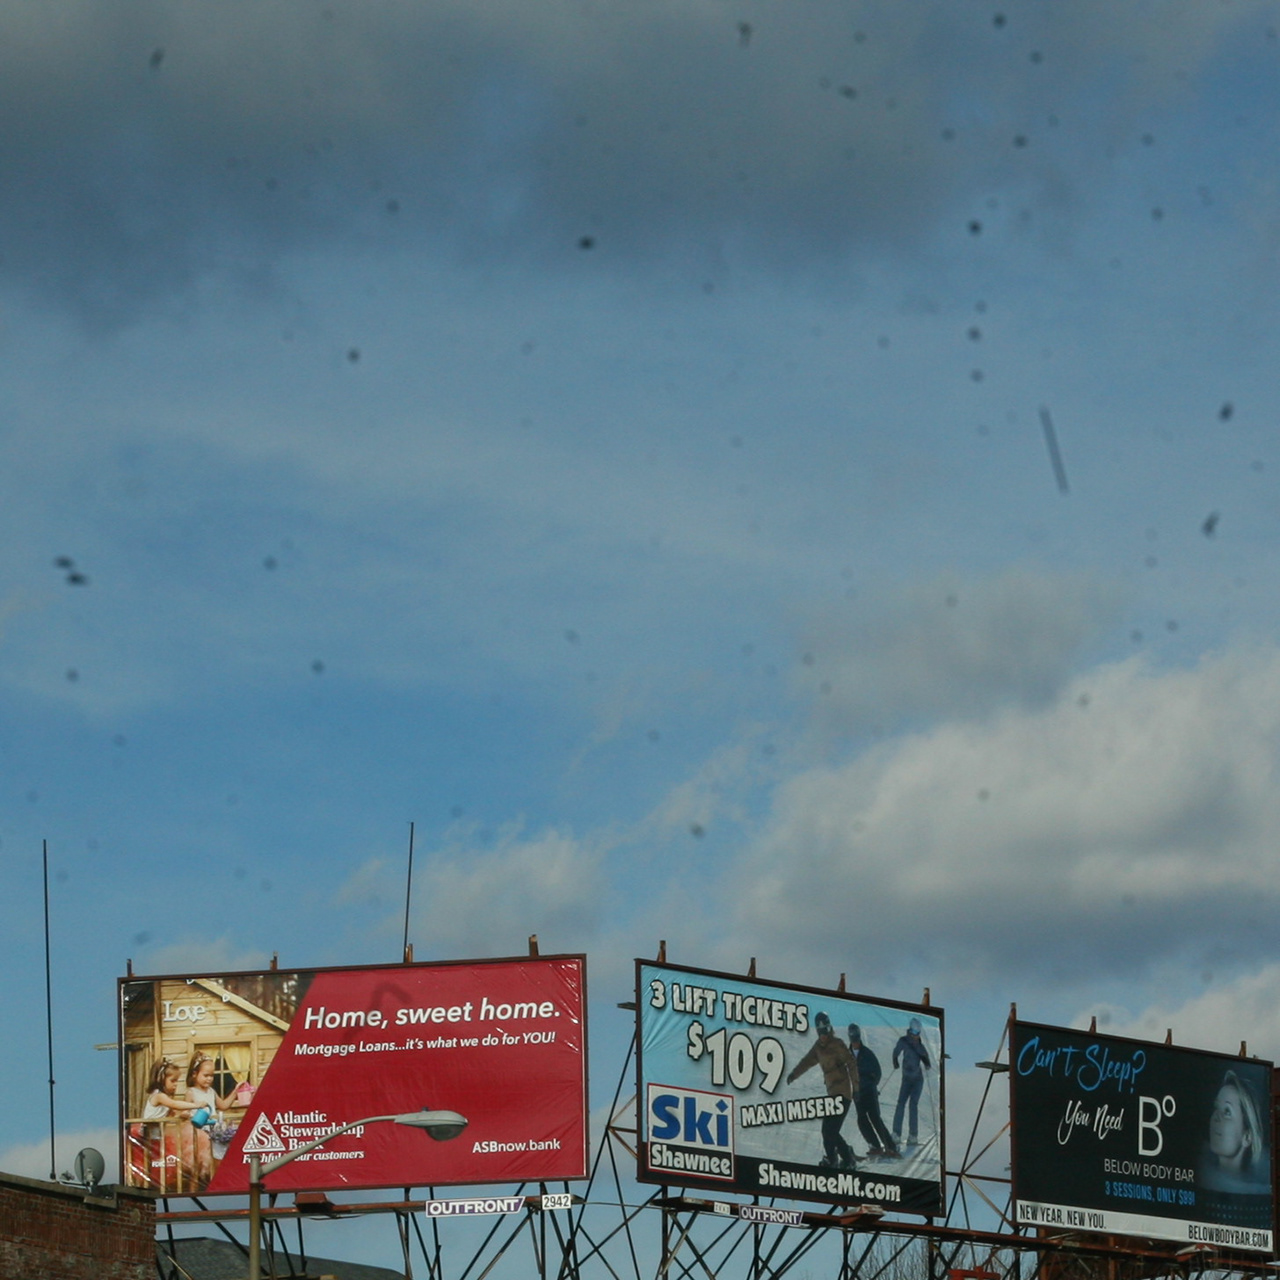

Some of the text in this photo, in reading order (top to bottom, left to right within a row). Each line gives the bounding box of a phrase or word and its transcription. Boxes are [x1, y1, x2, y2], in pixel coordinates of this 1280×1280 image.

[163, 1001, 206, 1023] Love
[304, 997, 560, 1030] Home, sweet home.
[650, 979, 809, 1032] 3 LIFT TICKETS
[294, 1042, 355, 1057] Mortgage
[426, 1036, 458, 1049] what
[460, 1038, 478, 1048] we
[482, 1034, 499, 1046] do
[501, 1033, 520, 1047] for
[522, 1031, 555, 1044] YOU!
[687, 1020, 785, 1094] $109
[1077, 1044, 1146, 1094] Sleep?
[273, 1110, 327, 1125] Atlantic
[651, 1094, 729, 1147] Ski
[741, 1095, 845, 1128] MAXI MISERS
[1058, 1099, 1125, 1145] You Need
[314, 1150, 365, 1161] customers
[472, 1138, 561, 1153] ASBnow.bank
[651, 1143, 731, 1175] Shawnee
[1104, 1158, 1195, 1183] BELOW BODY BAR
[758, 1163, 901, 1202] ShawneeMt.com
[1105, 1181, 1111, 1196] 3
[1156, 1187, 1176, 1203] ONLY
[429, 1198, 520, 1214] OUTFRONT
[543, 1196, 570, 1208] 2942
[740, 1206, 799, 1224] OUTFRONT
[1020, 1204, 1107, 1229] NEW YEAR, NEW YOU.
[1188, 1224, 1269, 1247] BELOWBODYBAR.COM
